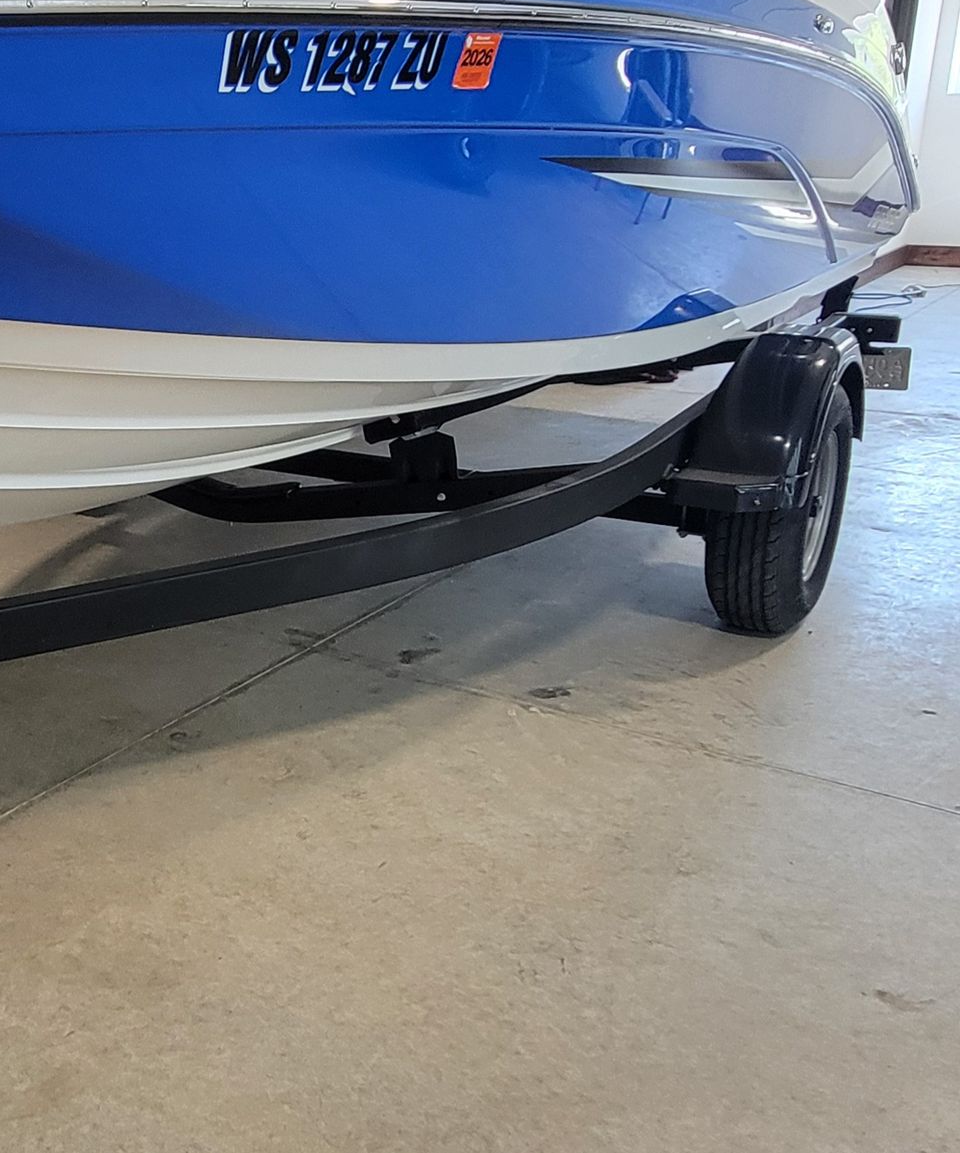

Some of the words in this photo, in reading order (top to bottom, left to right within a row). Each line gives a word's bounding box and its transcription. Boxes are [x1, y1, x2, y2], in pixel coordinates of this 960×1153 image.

[218, 29, 299, 93] WS
[301, 30, 401, 96] 1287
[390, 31, 452, 90] ZU
[461, 48, 494, 67] 2026
